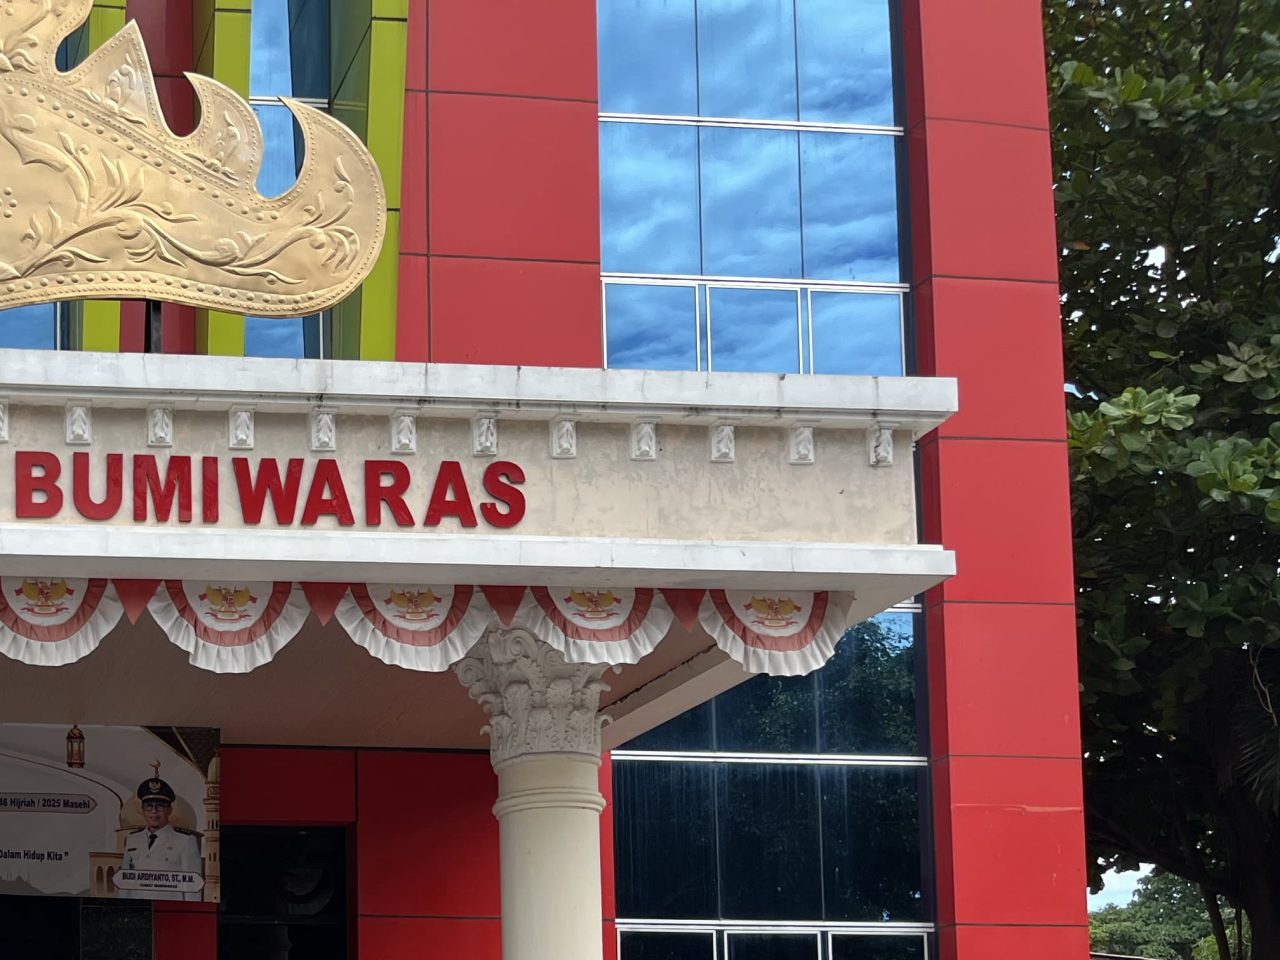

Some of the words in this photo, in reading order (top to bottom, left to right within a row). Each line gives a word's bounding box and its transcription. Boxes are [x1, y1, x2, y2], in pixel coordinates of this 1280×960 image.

[10, 798, 35, 809] Hijriah
[42, 798, 61, 808] 2025
[63, 799, 90, 809] Masehi
[23, 850, 44, 861] Hidup
